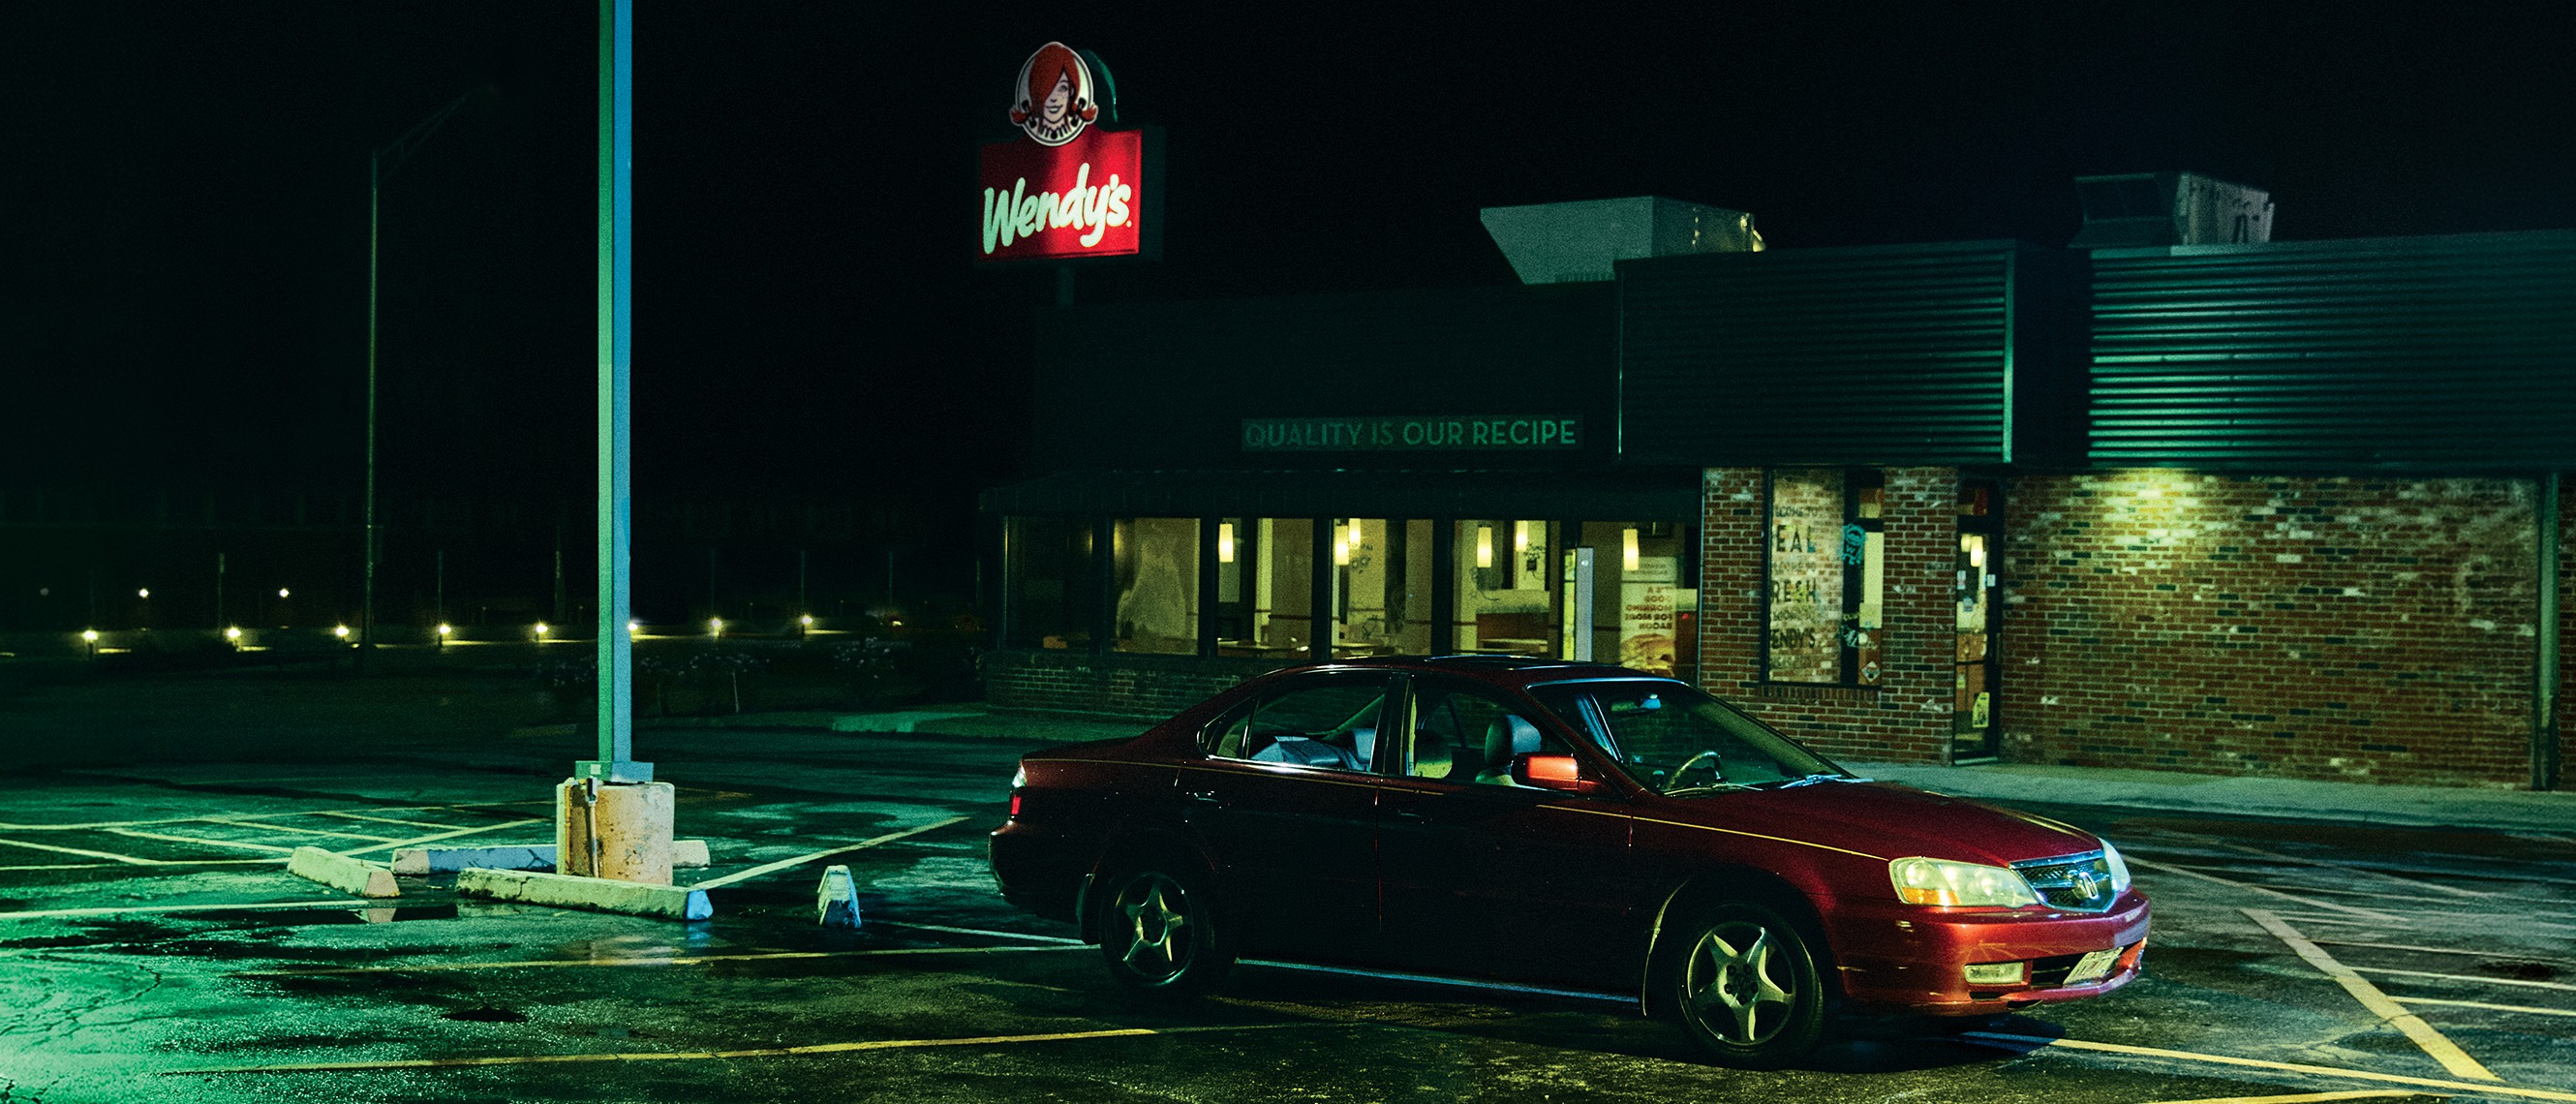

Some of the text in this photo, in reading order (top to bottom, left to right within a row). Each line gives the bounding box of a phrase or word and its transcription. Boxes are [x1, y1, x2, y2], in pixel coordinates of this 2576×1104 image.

[982, 162, 1132, 255] Wendy's
[1245, 419, 1577, 446] QUALITY IS OUR RECIPE
